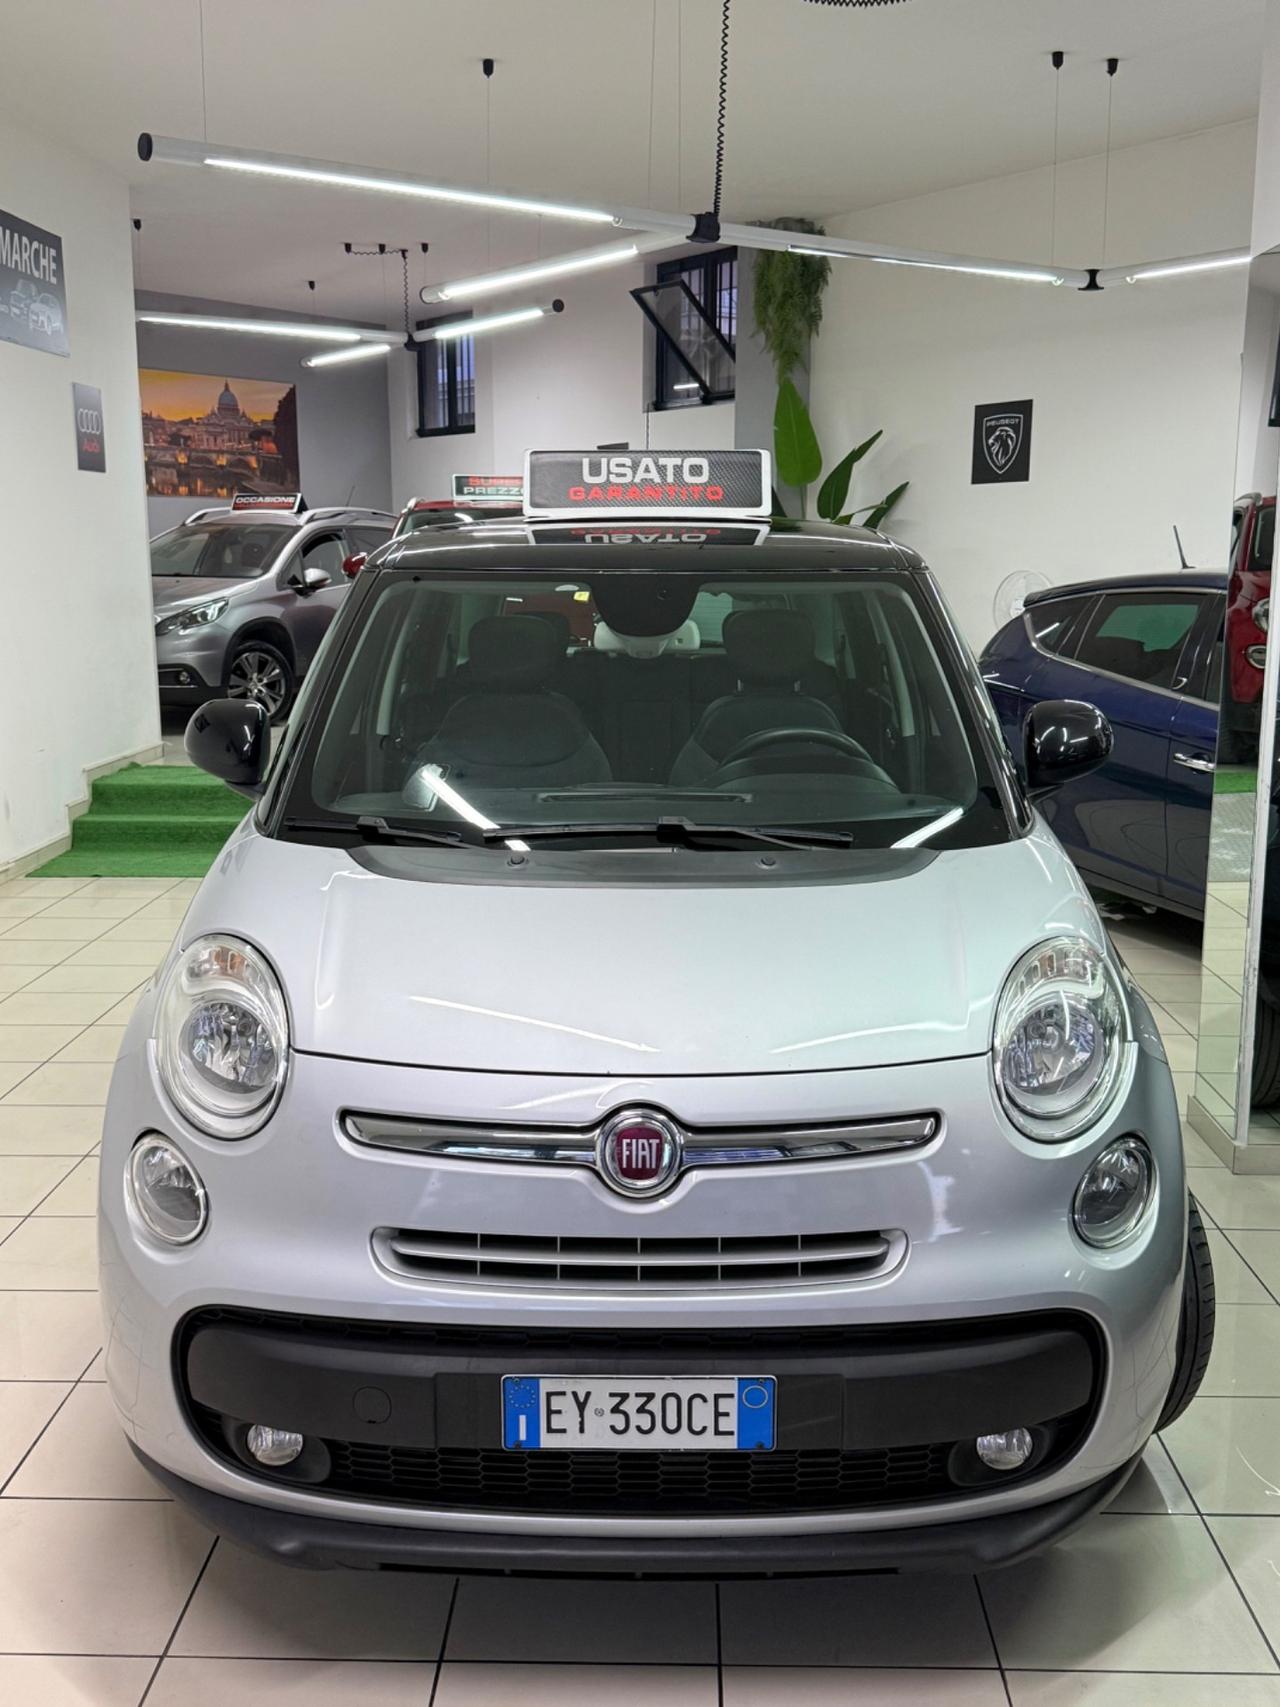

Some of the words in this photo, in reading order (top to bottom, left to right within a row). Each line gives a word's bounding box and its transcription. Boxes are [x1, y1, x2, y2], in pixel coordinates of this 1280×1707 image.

[0, 226, 57, 284] MARCHE
[986, 418, 1020, 427] PEUGEOT
[582, 457, 710, 484] USATO
[235, 496, 296, 504] OCCASIONE
[568, 486, 723, 501] GARANTITO
[622, 1138, 660, 1169] FIAT
[545, 1390, 592, 1434] EY
[608, 1391, 735, 1436] 330CE
